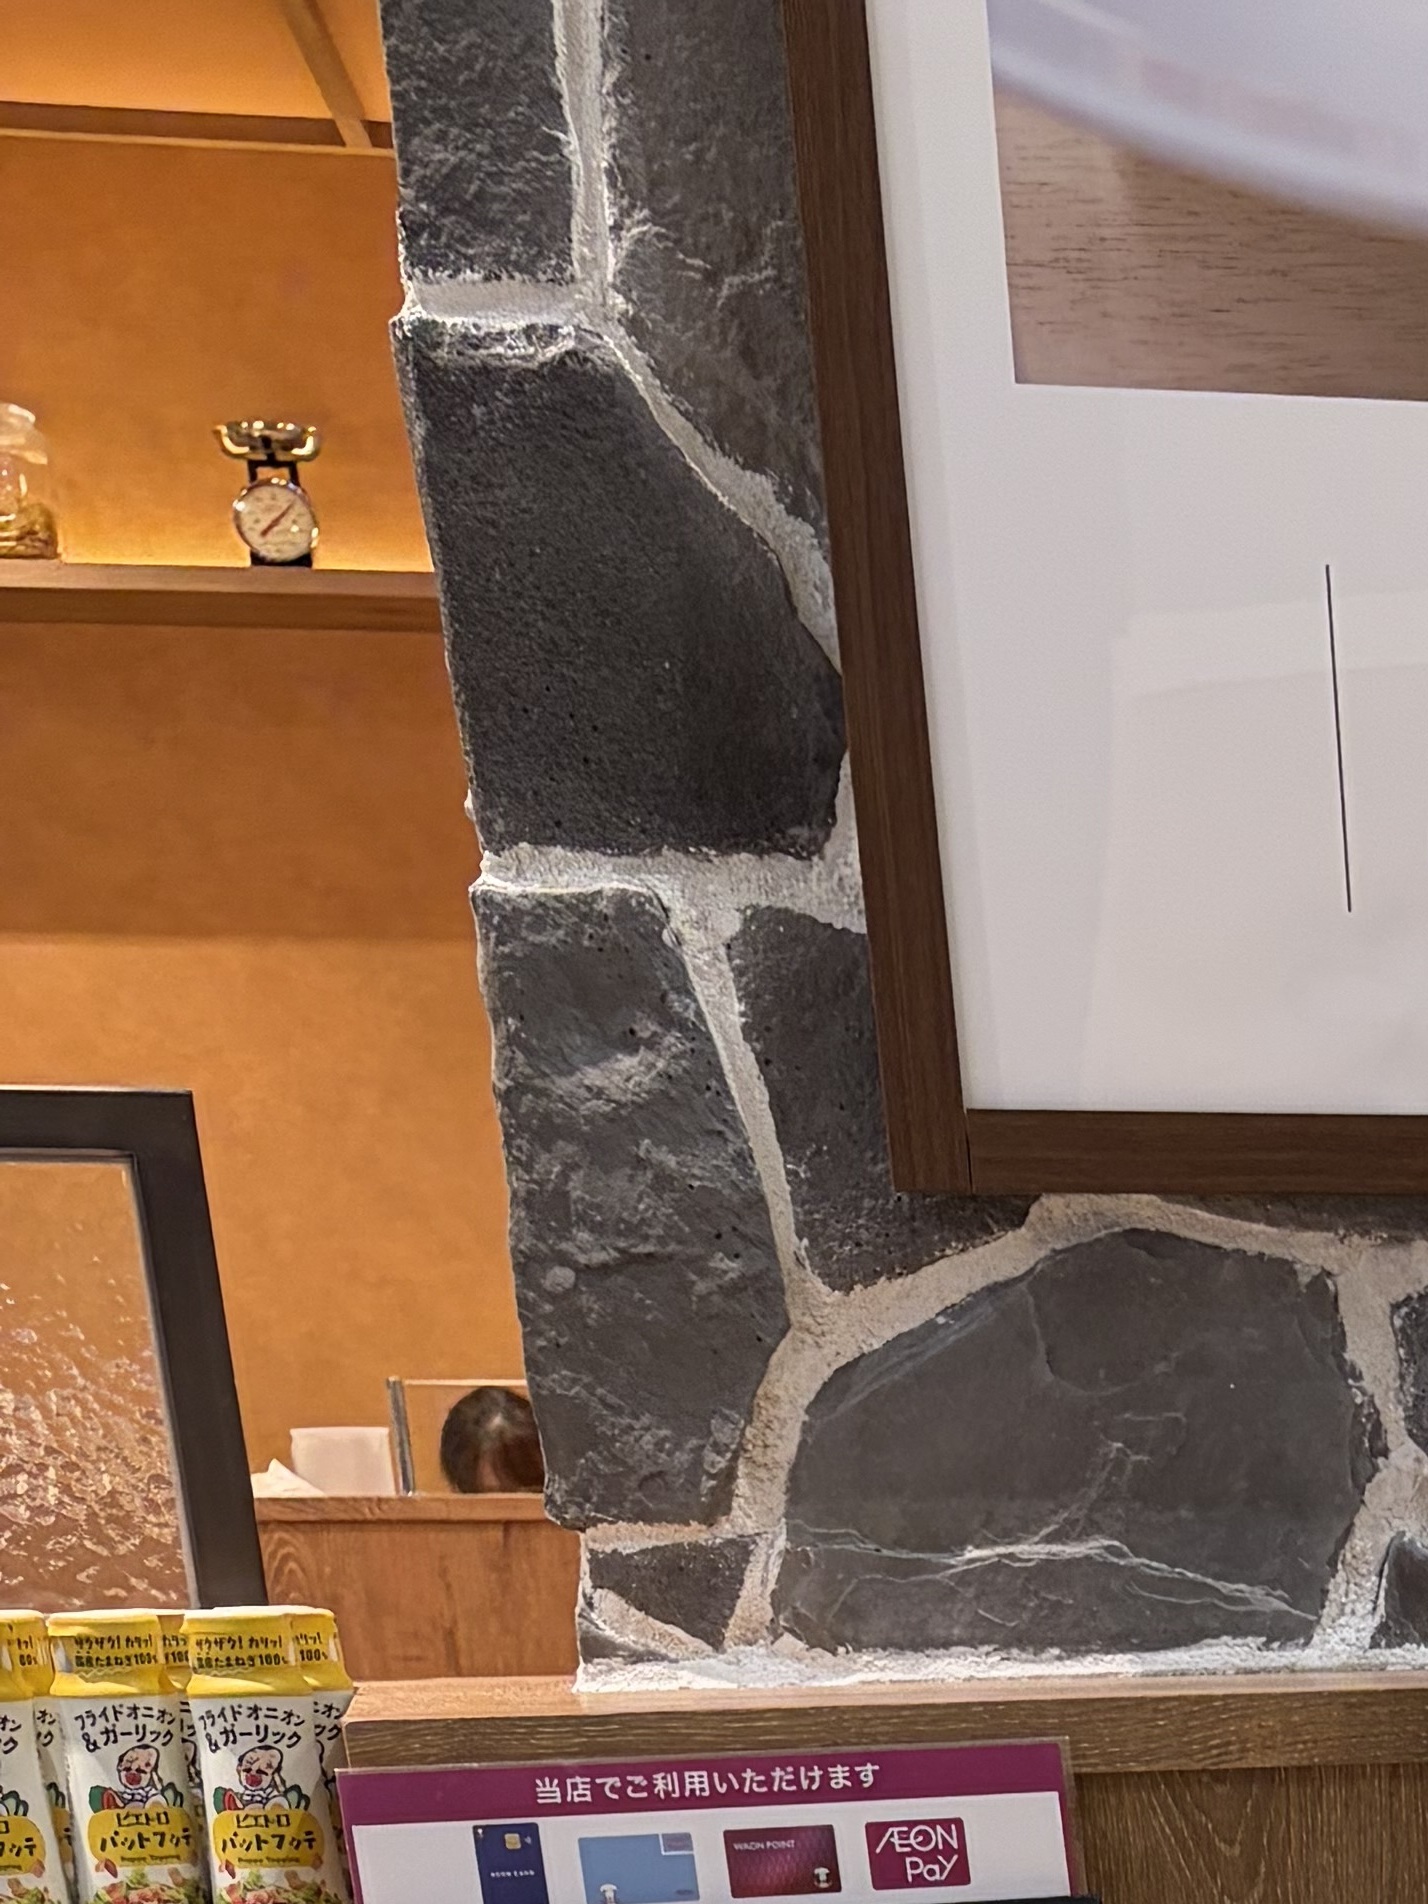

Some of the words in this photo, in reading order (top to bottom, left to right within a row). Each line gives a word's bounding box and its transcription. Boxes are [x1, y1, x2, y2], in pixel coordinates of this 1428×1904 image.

[74, 1703, 176, 1731] フライドオニオン
[199, 1703, 305, 1731] フライドオニオン
[535, 1762, 880, 1804] 当店でご利用いただけます
